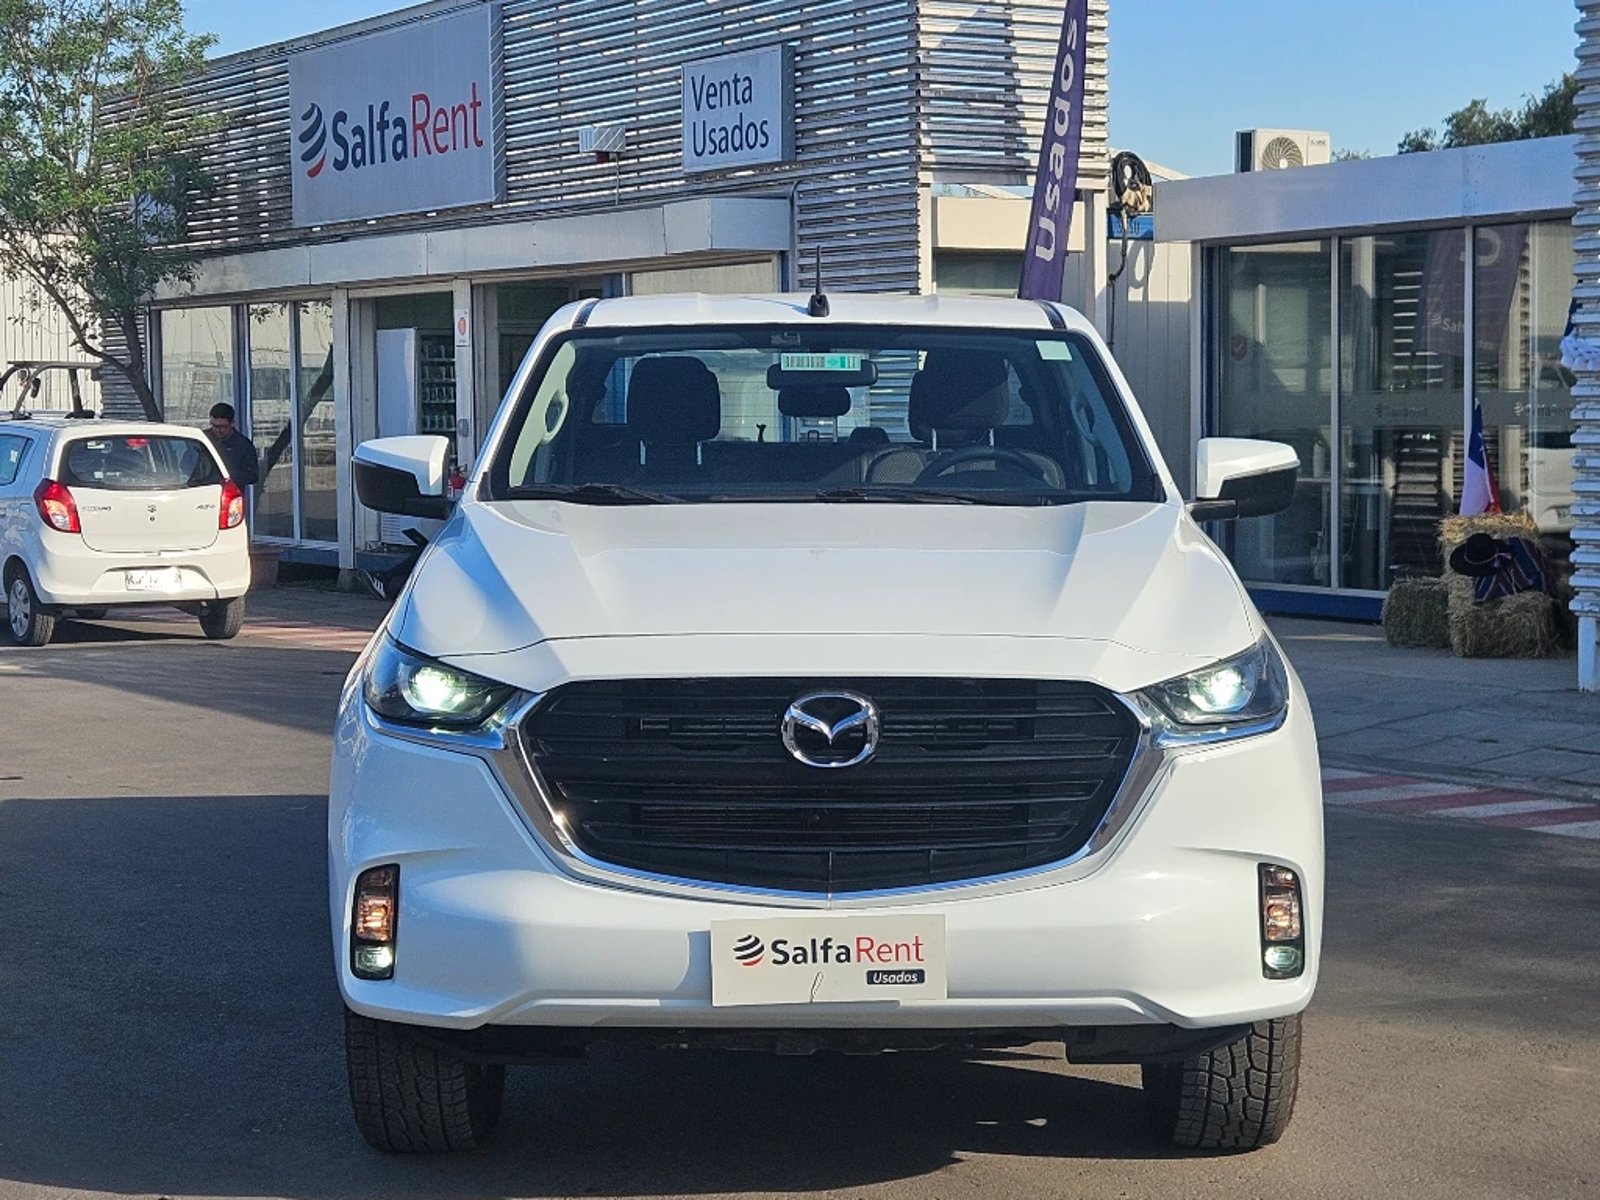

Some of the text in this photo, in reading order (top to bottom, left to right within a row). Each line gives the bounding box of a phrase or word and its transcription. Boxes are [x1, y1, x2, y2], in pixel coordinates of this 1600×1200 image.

[691, 72, 752, 111] Venta
[332, 82, 483, 171] SalfaRent
[693, 112, 769, 157] Usados
[1035, 18, 1078, 262] Usados
[771, 935, 925, 966] SalfaRent
[873, 971, 918, 984] Usados
